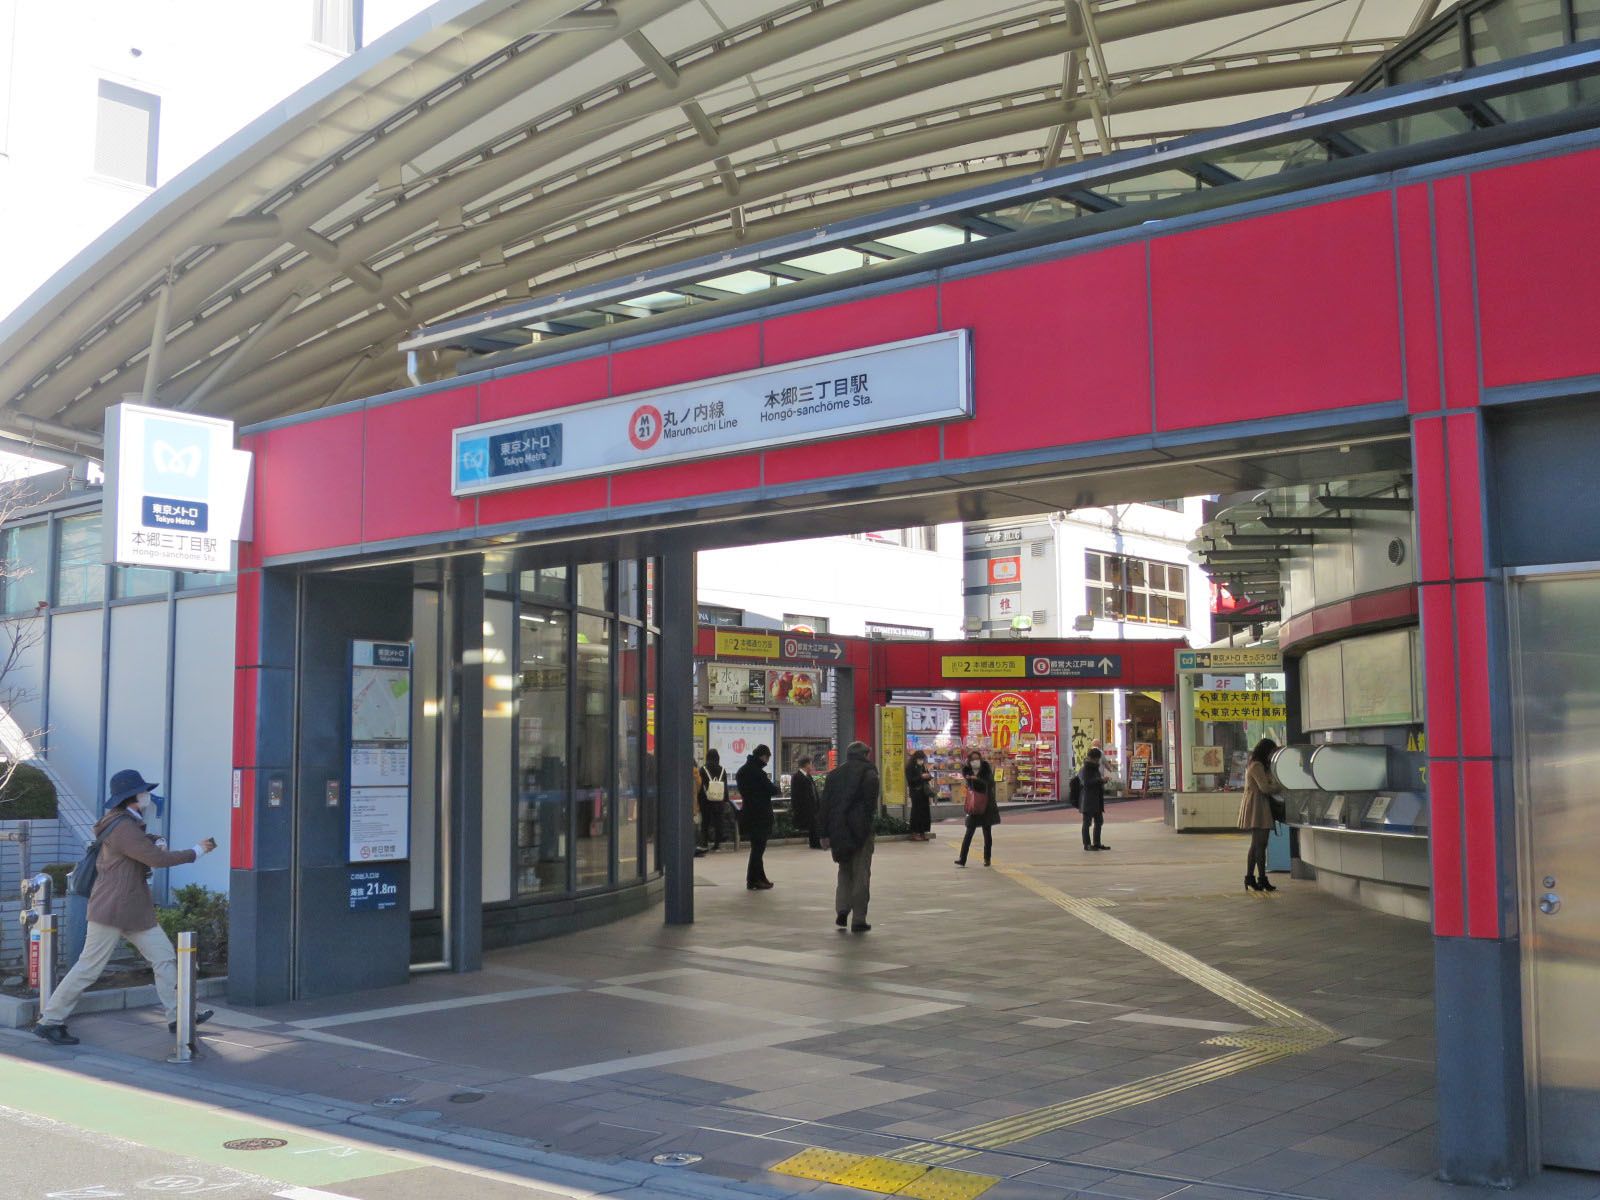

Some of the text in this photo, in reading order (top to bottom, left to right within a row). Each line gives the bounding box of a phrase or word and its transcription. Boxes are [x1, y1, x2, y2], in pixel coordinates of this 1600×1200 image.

[764, 373, 869, 408] 本郷三丁目駅
[852, 395, 873, 407] Sta.
[640, 415, 650, 425] M
[663, 401, 725, 428] 丸ノ内線
[639, 427, 650, 438] 21
[663, 419, 738, 440] Marunouchi Line
[500, 435, 550, 456] 東京メトロ
[503, 452, 547, 467] Tokyo Metro
[152, 503, 198, 518] 東京メトロ
[155, 514, 195, 526] Tokyo Metro
[131, 530, 217, 553] 本郷三丁目駅
[733, 638, 739, 650] 2
[963, 661, 971, 673] 2
[973, 661, 1016, 669] 本郷通り方面
[1050, 660, 1095, 669] 都営大江戸線
[1216, 679, 1231, 689] 2F
[366, 882, 397, 896] 21.8m
